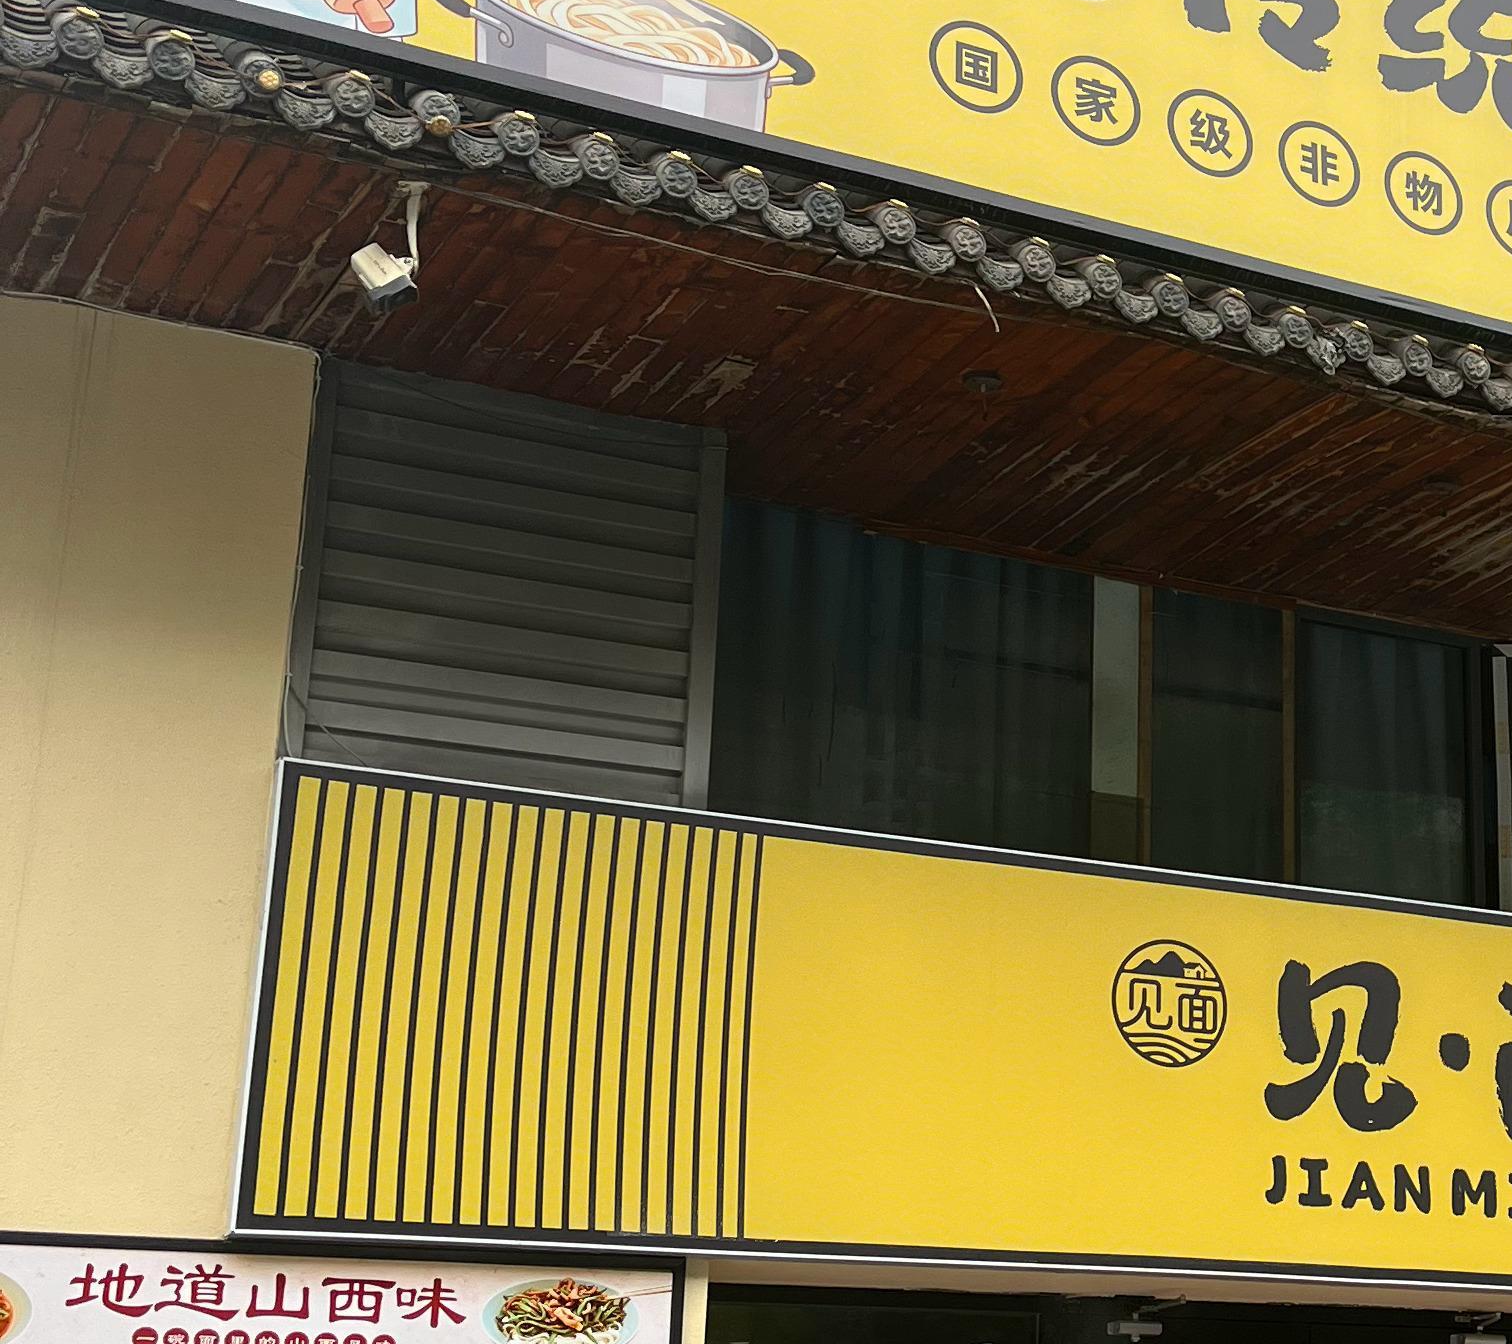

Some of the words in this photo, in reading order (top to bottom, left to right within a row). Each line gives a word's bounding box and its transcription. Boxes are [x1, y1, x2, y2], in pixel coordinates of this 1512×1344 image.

[1264, 1155, 1431, 1215] JIAN
[64, 1262, 468, 1329] 地道山西味
